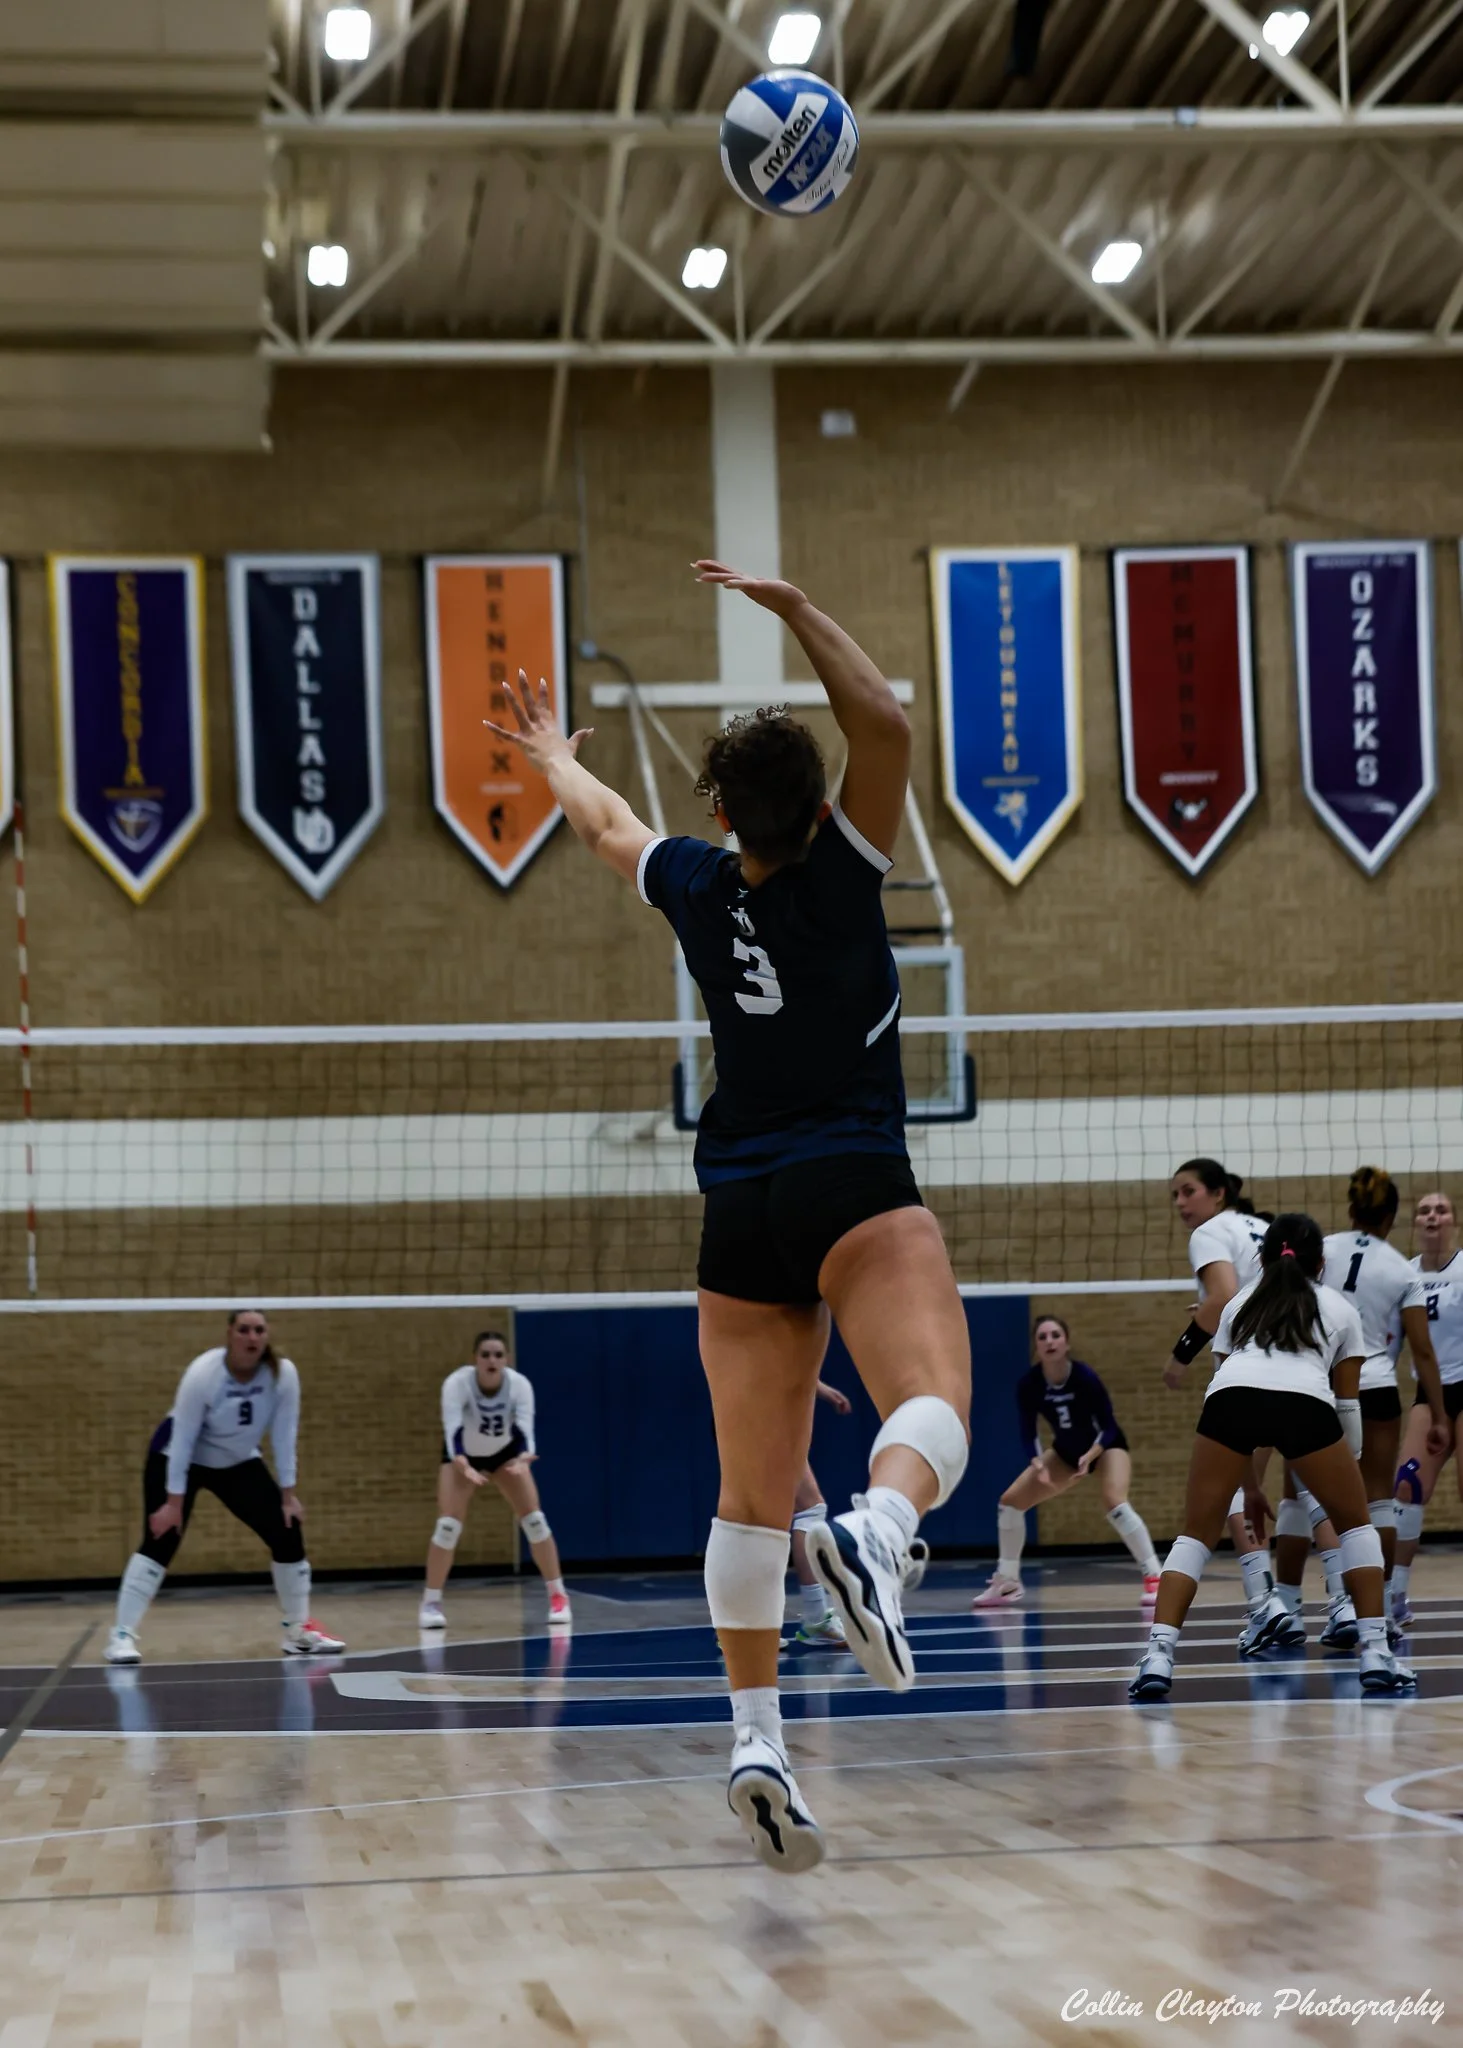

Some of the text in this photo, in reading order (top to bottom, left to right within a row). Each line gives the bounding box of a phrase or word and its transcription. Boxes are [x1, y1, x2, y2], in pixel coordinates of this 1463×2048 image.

[763, 104, 817, 180] molten
[785, 124, 834, 191] NCAA
[292, 586, 326, 803] DALLAS
[1350, 570, 1380, 787] OZARKS
[733, 937, 784, 1015] 3
[1343, 1252, 1364, 1293] 1
[238, 1401, 253, 1426] 9
